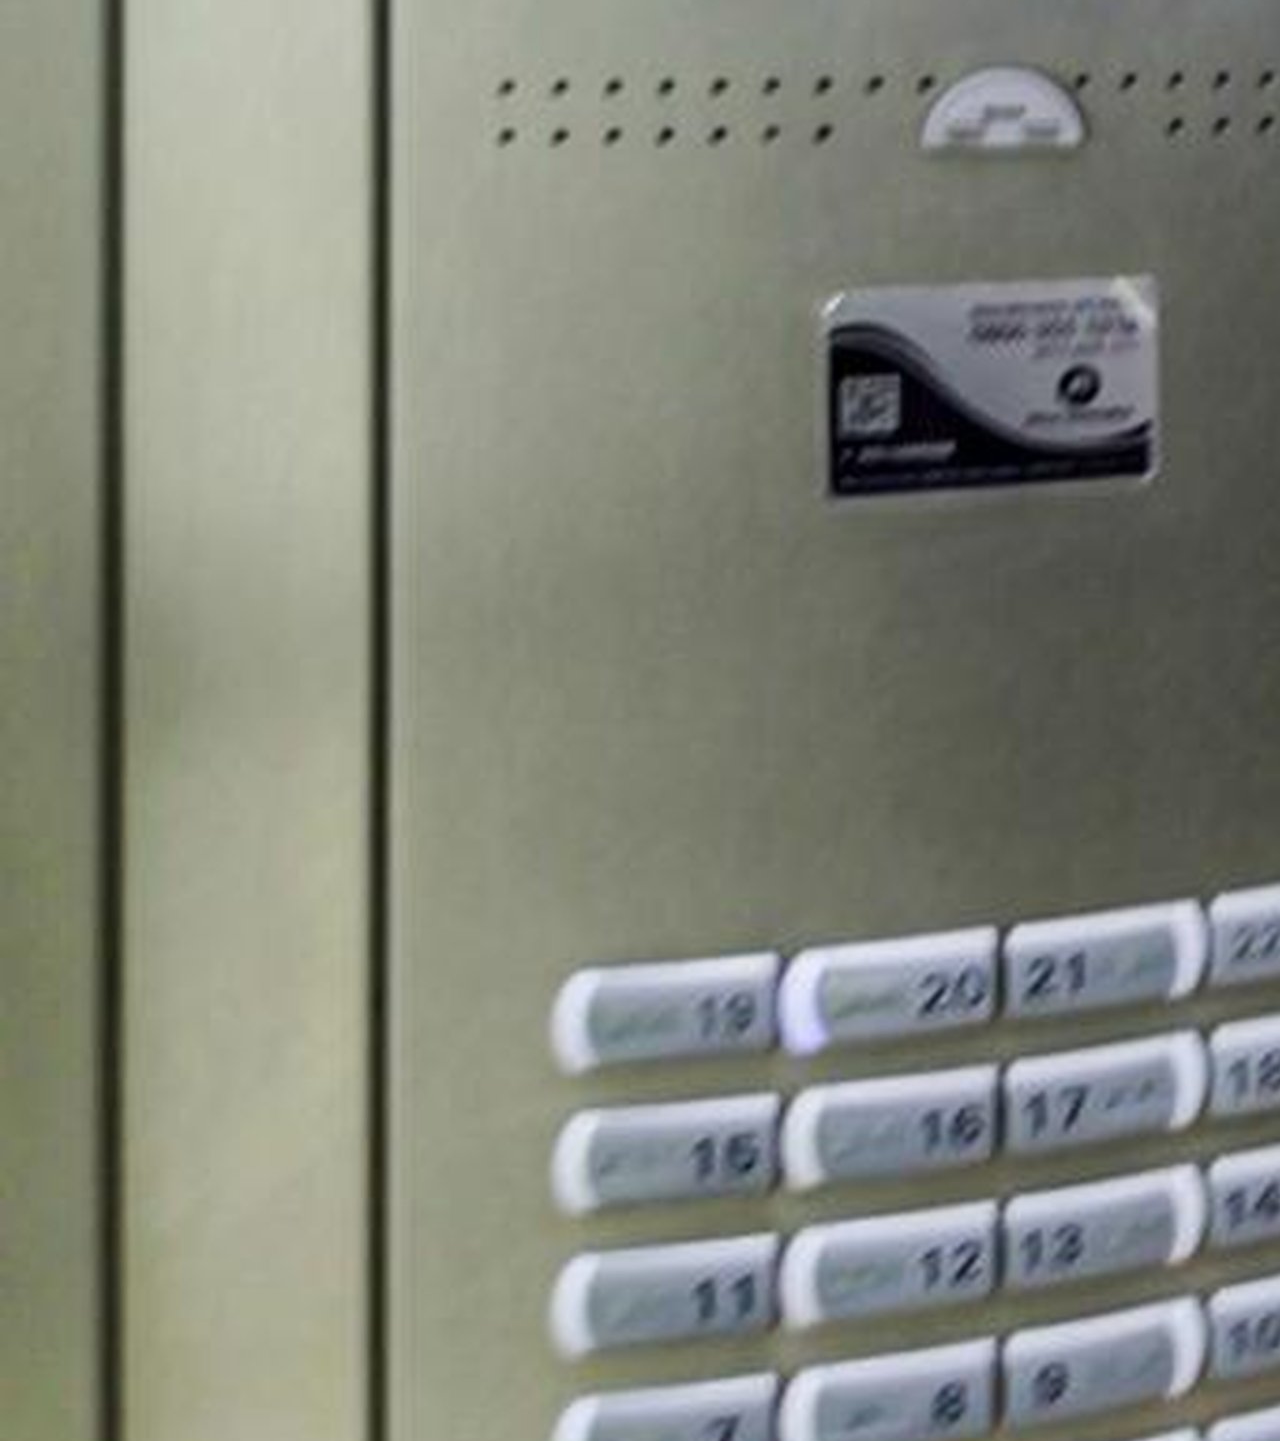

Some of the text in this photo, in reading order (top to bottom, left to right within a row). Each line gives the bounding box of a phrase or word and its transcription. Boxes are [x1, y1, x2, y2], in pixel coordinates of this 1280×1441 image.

[918, 958, 988, 1017] 20
[1024, 951, 1087, 1001] 21
[699, 991, 756, 1037] 19
[921, 1103, 986, 1155] 16
[1022, 1083, 1089, 1138] 17
[691, 1132, 759, 1179] 15
[918, 1238, 982, 1286] 12
[1021, 1220, 1085, 1269] 13
[691, 1276, 757, 1320] 11
[931, 1381, 967, 1427] 8
[1034, 1362, 1067, 1407] 9
